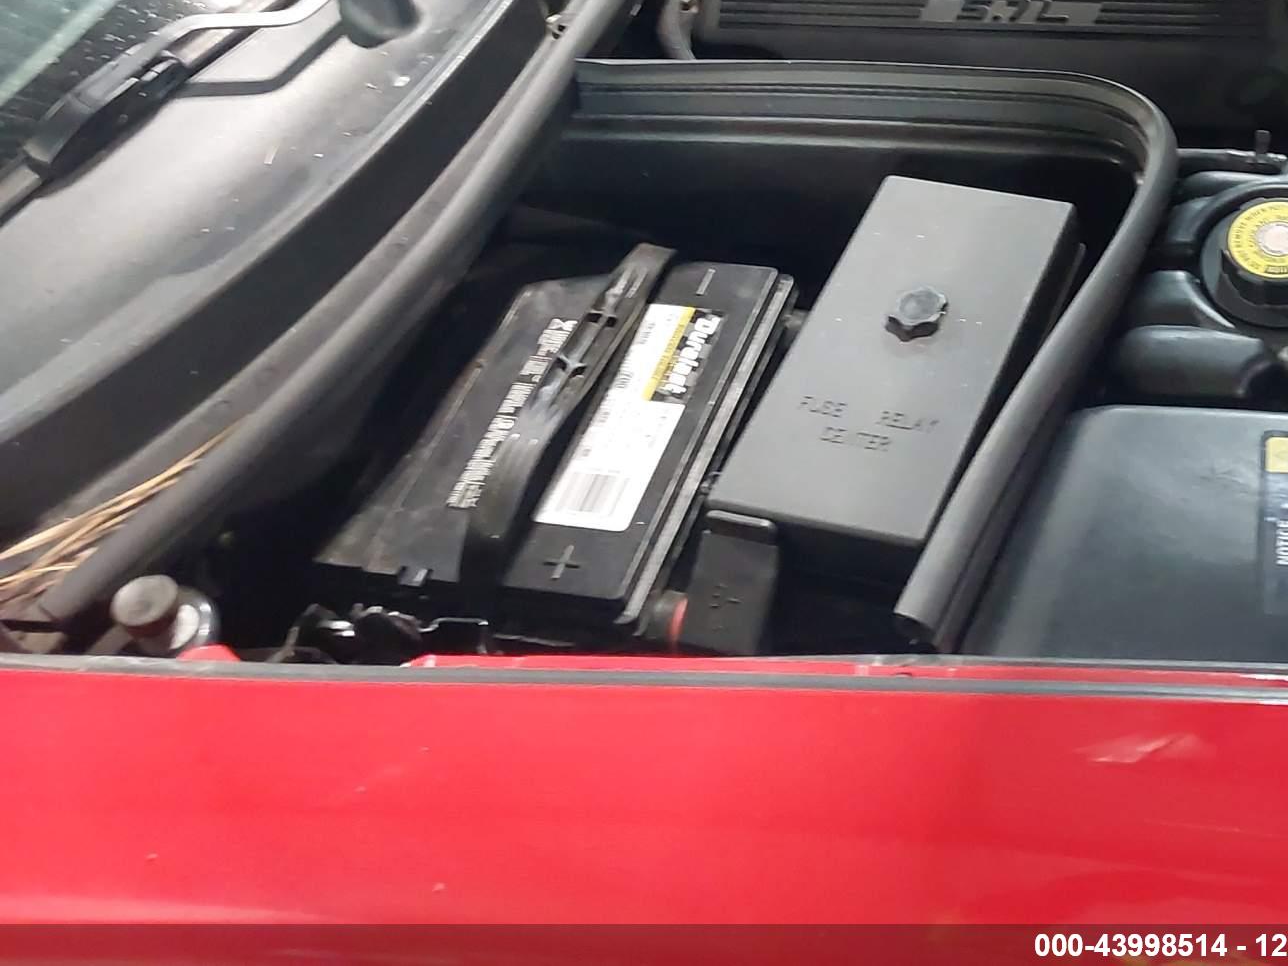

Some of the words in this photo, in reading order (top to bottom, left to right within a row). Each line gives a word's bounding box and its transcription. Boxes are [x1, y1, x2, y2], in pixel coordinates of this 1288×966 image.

[797, 395, 848, 419] FUSE
[874, 410, 941, 432] RELAY
[818, 426, 892, 452] CENTER
